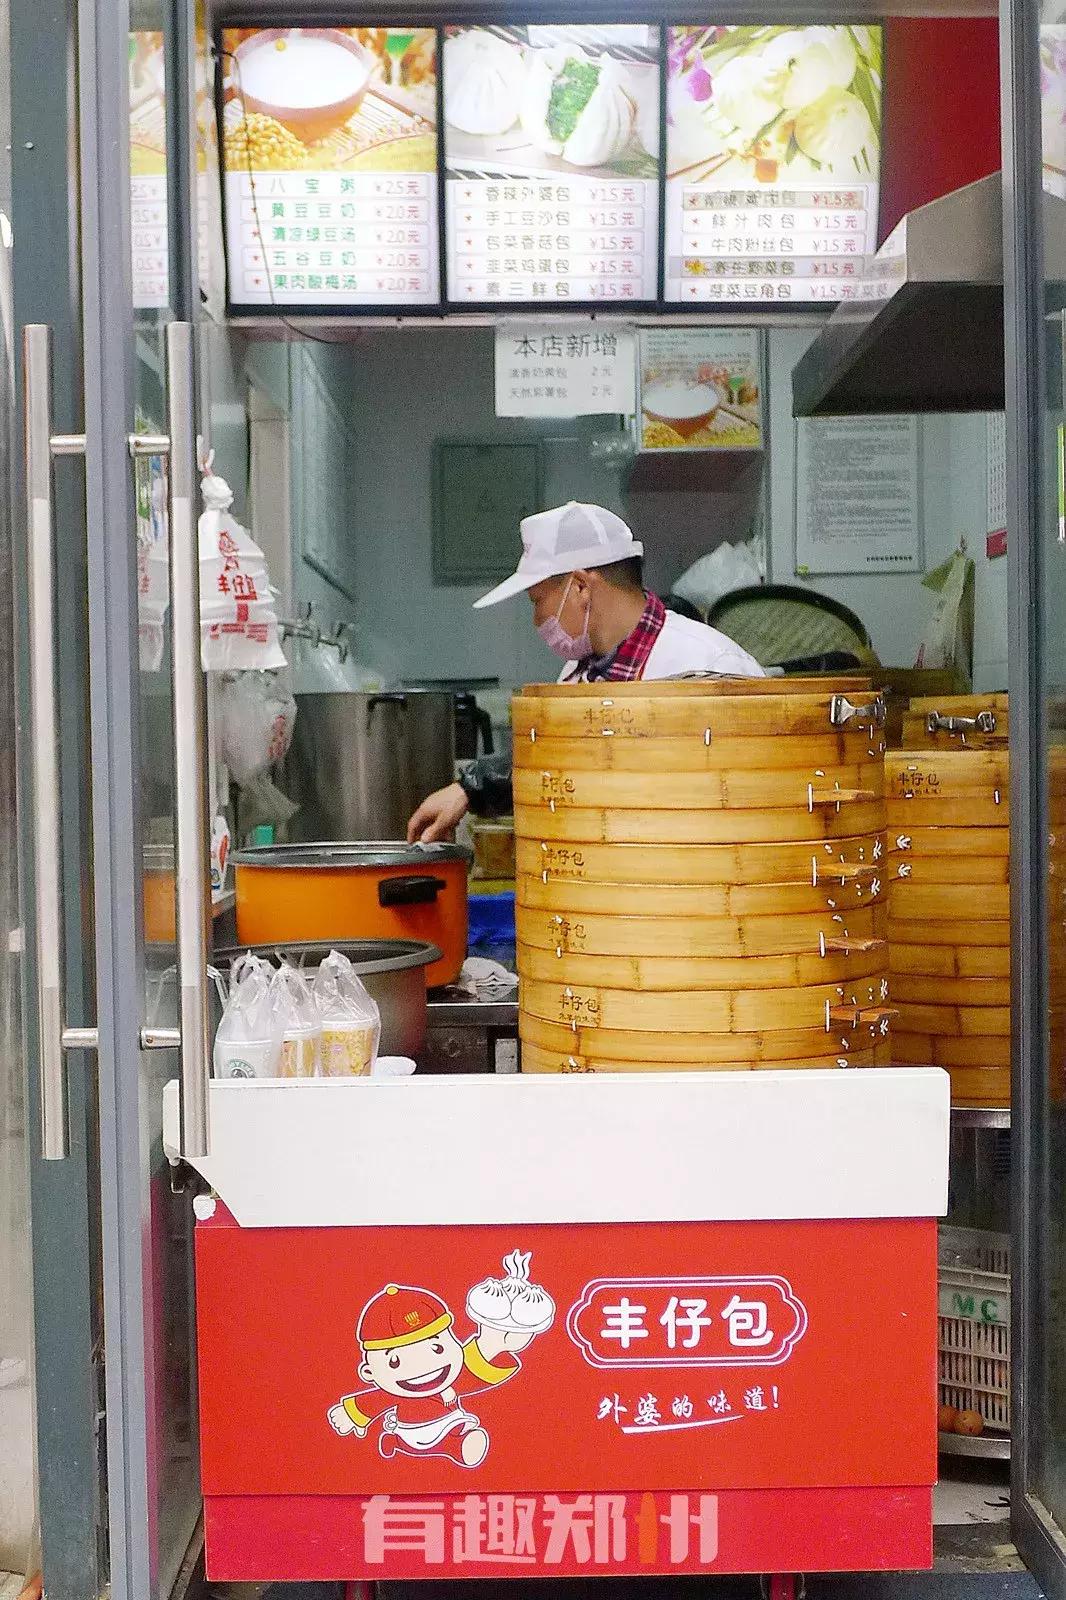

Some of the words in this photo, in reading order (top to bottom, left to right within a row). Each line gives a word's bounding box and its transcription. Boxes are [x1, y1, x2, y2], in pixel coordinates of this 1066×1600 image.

[270, 178, 355, 193] 八宝粥
[272, 203, 355, 218] 黄豆豆奶
[486, 211, 570, 226] 手工豆沙包
[712, 214, 795, 229] 鲜汁肉包
[272, 227, 356, 242] 清凉绿豆汤
[273, 251, 356, 266] 五谷豆奶
[274, 275, 358, 290] 果肉酸梅汤
[512, 332, 618, 359] 本店新增
[558, 993, 600, 1013] 丰仔包
[600, 1295, 774, 1348] 丰仔包
[597, 1385, 781, 1426] 外婆的味道!
